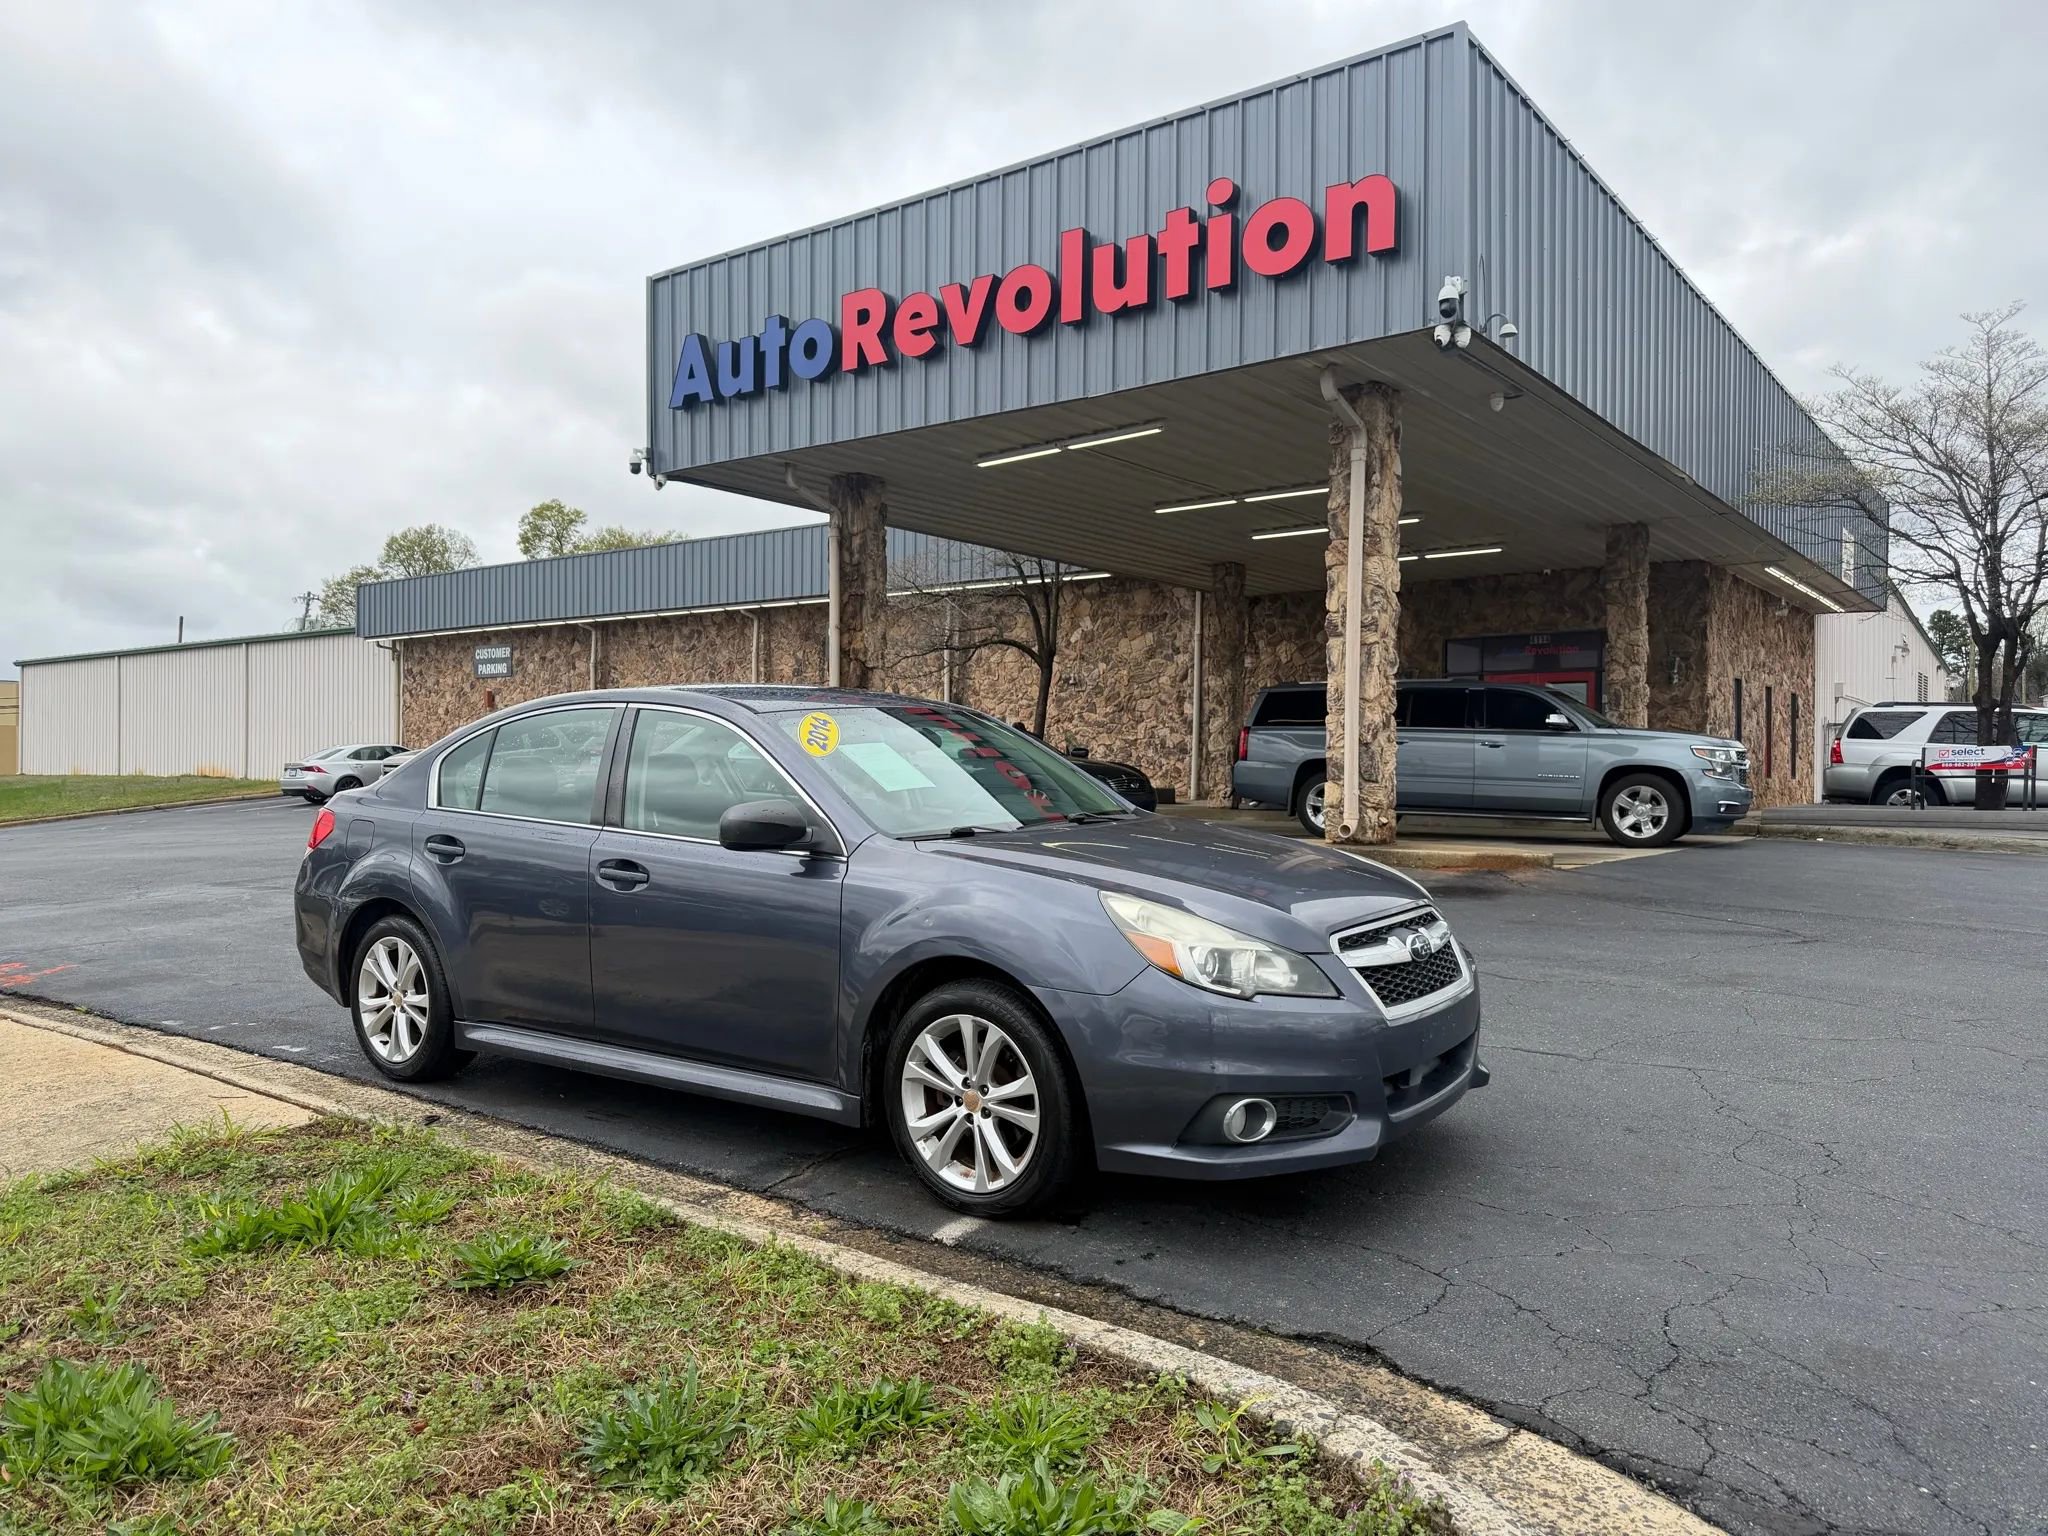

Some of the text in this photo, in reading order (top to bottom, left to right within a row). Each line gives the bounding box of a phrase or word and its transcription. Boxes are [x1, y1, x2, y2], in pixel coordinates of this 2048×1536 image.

[475, 647, 511, 659] CUSTOMER
[478, 663, 507, 674] PARKING
[807, 715, 832, 751] 2014
[1951, 748, 1985, 756] select
